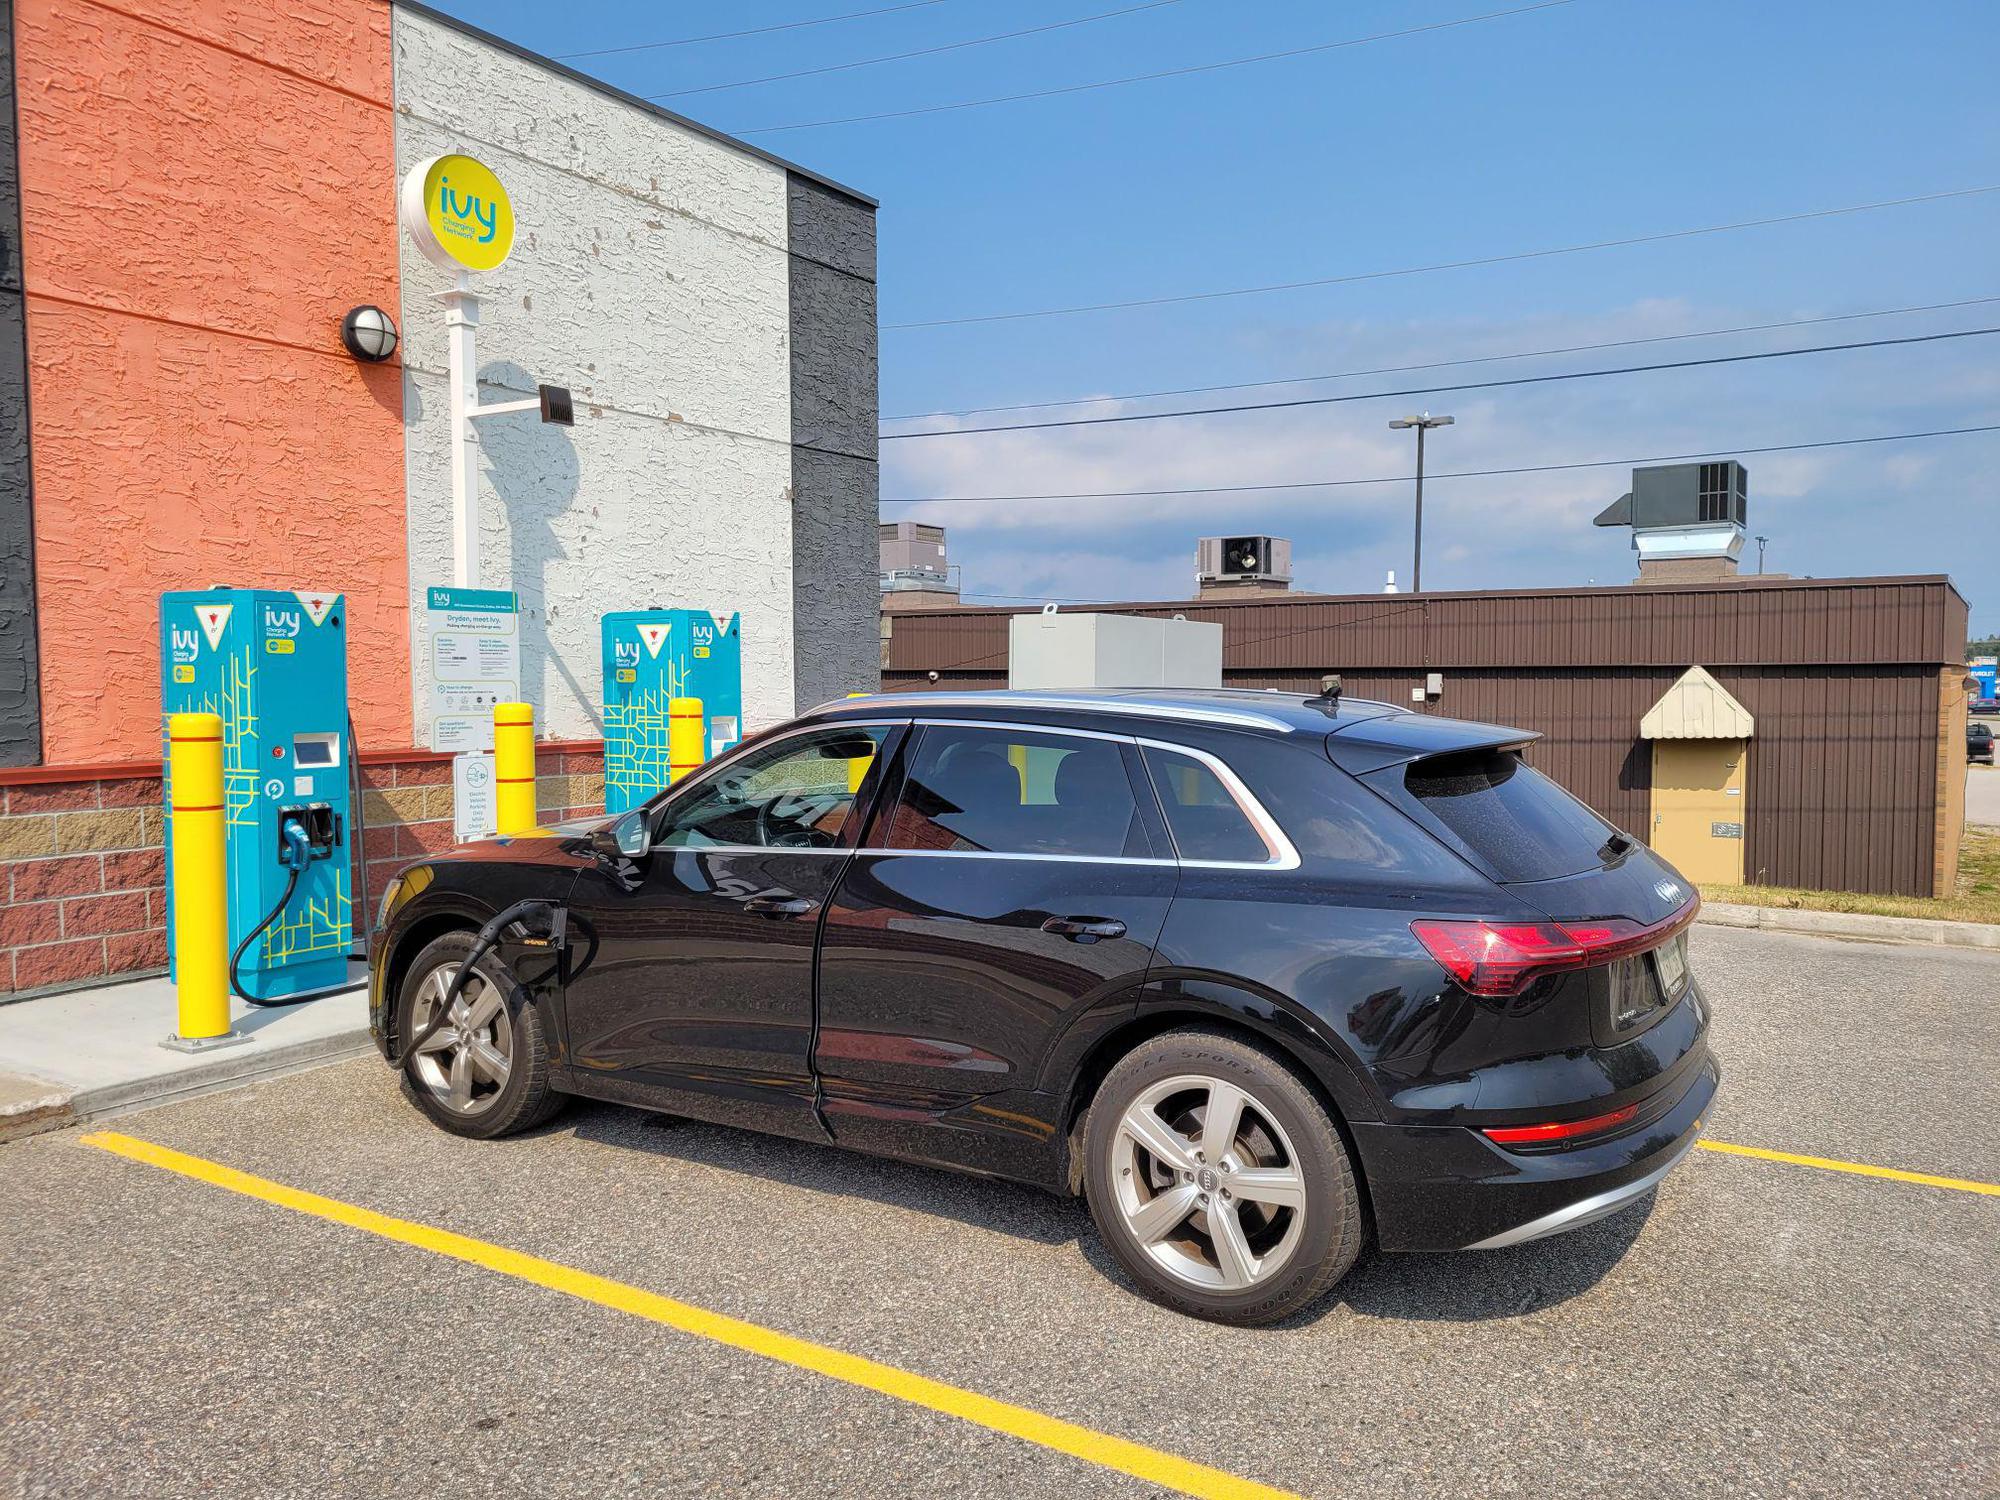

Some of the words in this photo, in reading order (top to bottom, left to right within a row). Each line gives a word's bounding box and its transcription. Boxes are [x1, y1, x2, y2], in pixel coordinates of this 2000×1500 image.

[441, 176, 496, 243] ivy
[442, 217, 475, 234] Charging
[443, 226, 474, 240] Network
[434, 591, 450, 606] ivy
[265, 605, 300, 637] ivy
[447, 614, 472, 623] Dryden,
[172, 623, 199, 662] ivy
[693, 621, 713, 645] ivy
[615, 637, 640, 667] ivy
[1181, 1050, 1257, 1077] SPORT
